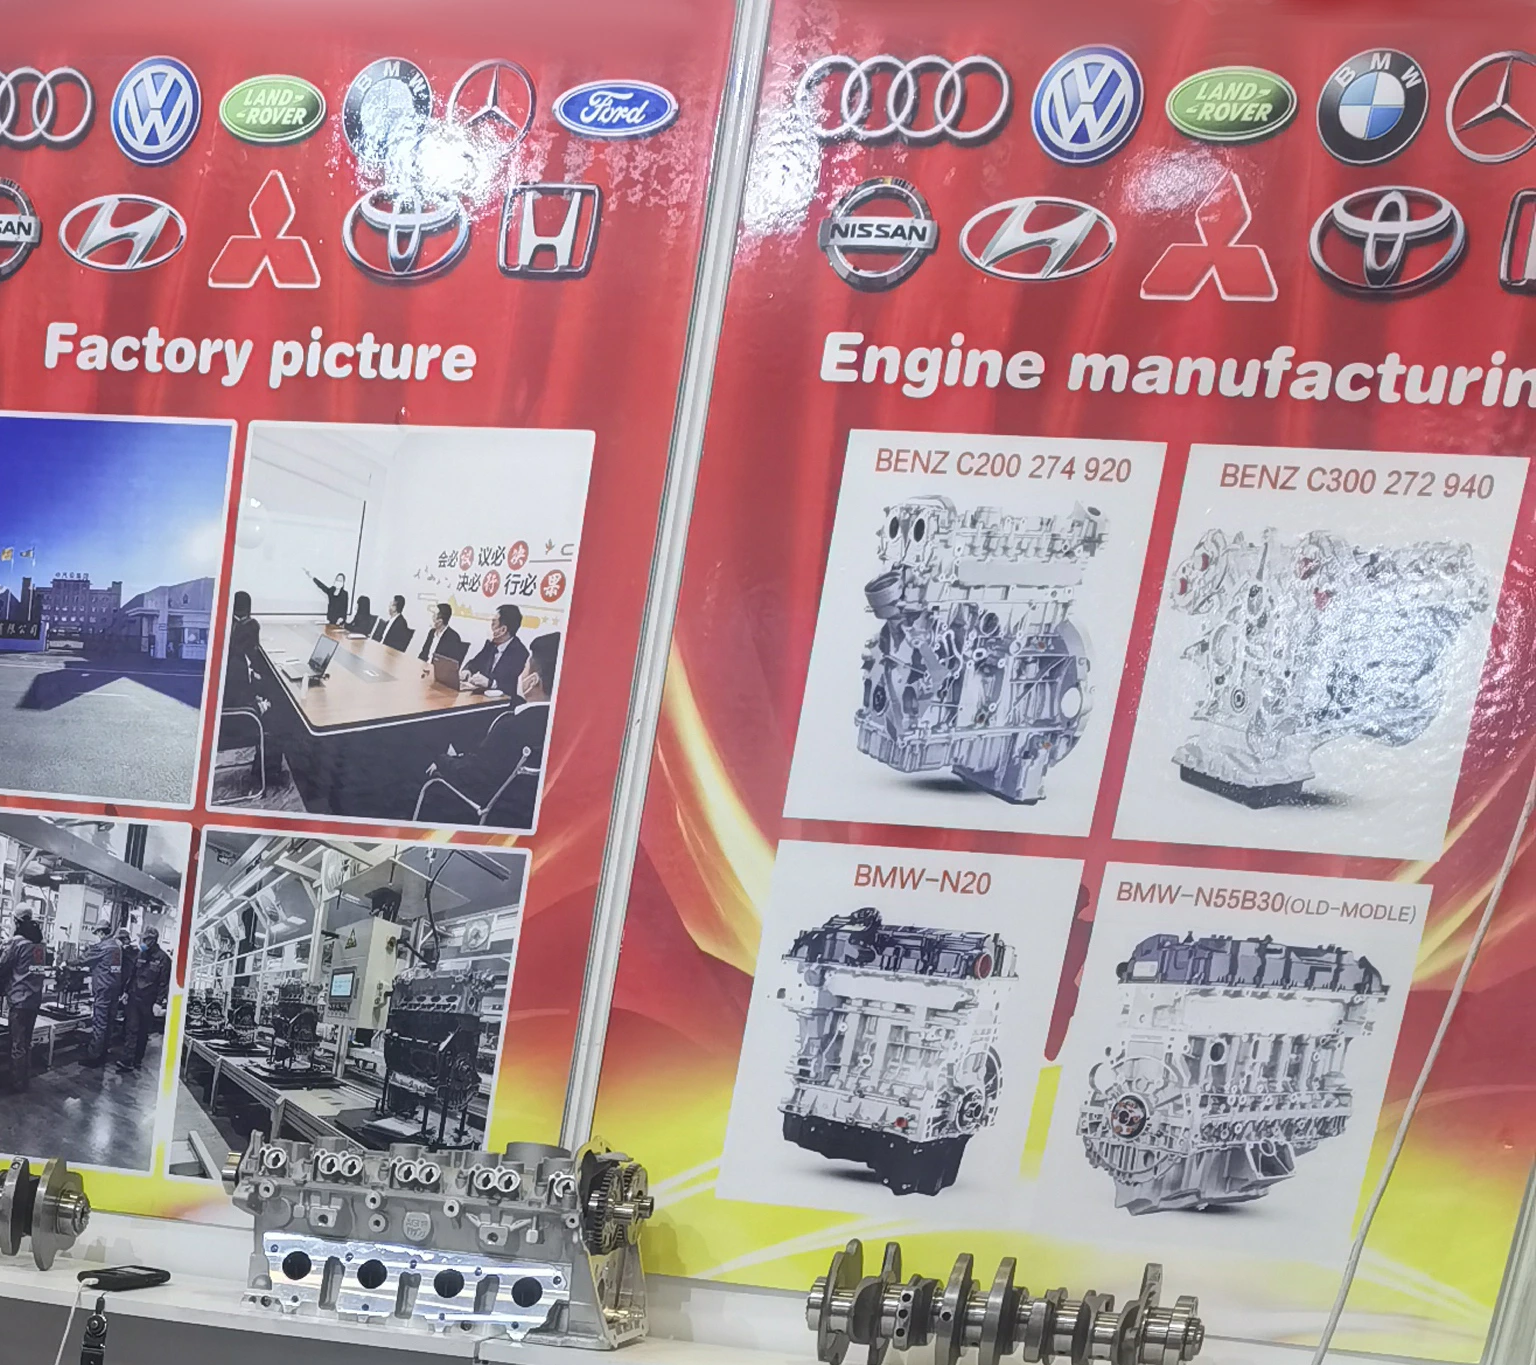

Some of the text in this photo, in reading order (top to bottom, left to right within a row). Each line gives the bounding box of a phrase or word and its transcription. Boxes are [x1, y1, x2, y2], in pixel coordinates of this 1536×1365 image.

[587, 91, 648, 126] Ford
[829, 222, 928, 242] NISSAN
[44, 321, 478, 389] Factory picture
[819, 332, 1045, 398] Engine
[874, 447, 1132, 484] BENZ C200 274 920
[1220, 462, 1494, 500] BENZ C300 272 940
[854, 863, 992, 896] BMW-N20
